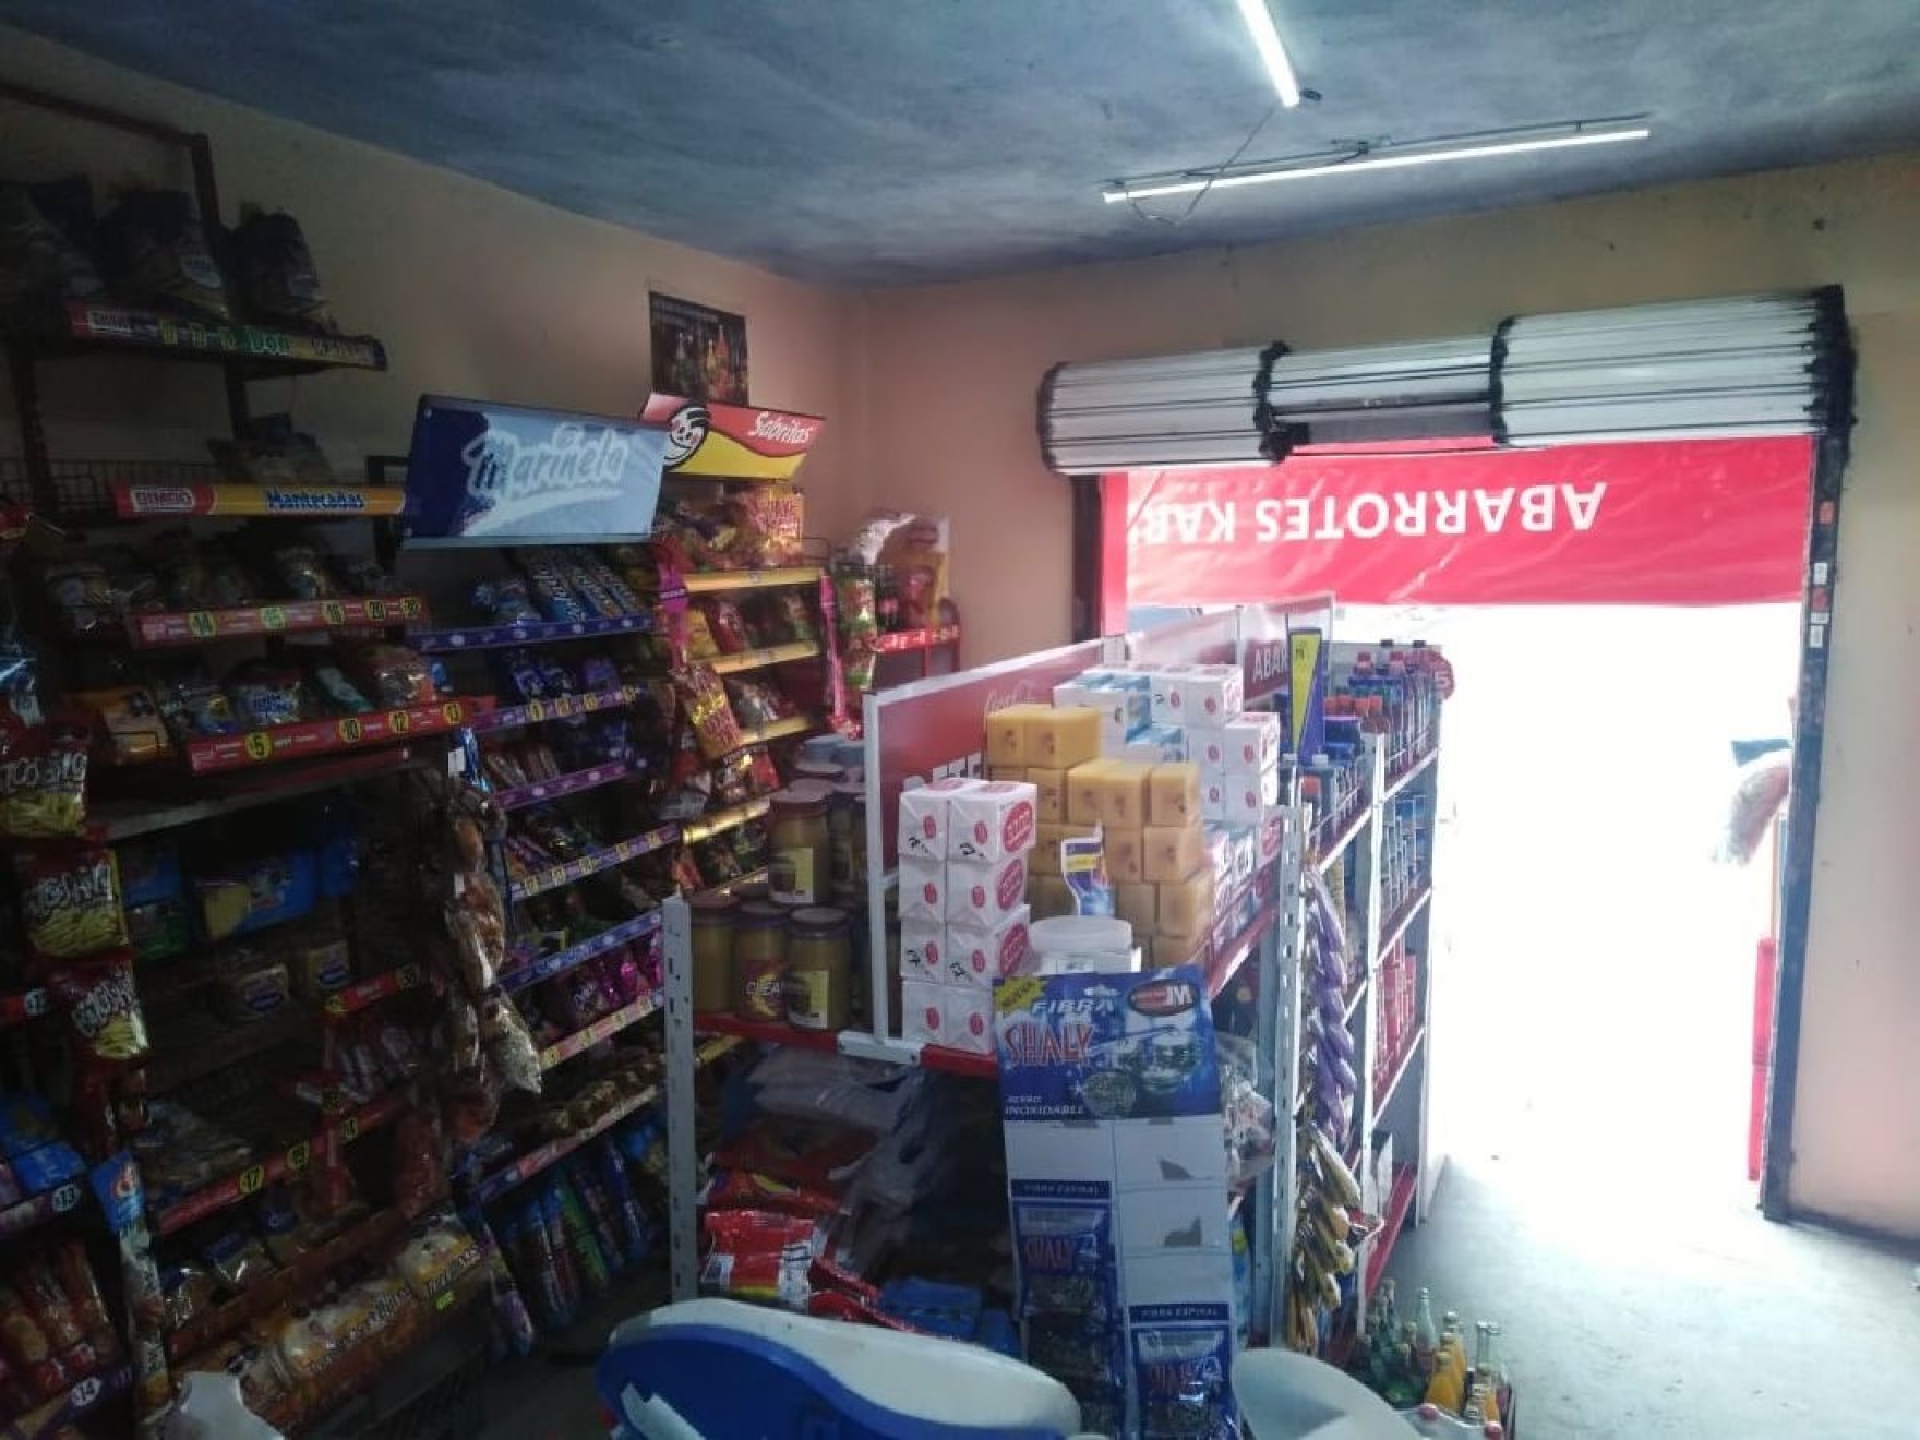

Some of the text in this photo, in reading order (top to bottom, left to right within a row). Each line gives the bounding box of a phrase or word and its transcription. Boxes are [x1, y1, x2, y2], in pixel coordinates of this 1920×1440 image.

[462, 422, 628, 499] Marinela
[1256, 482, 1608, 543] ABARROTES
[1032, 997, 1114, 1015] FIBRA
